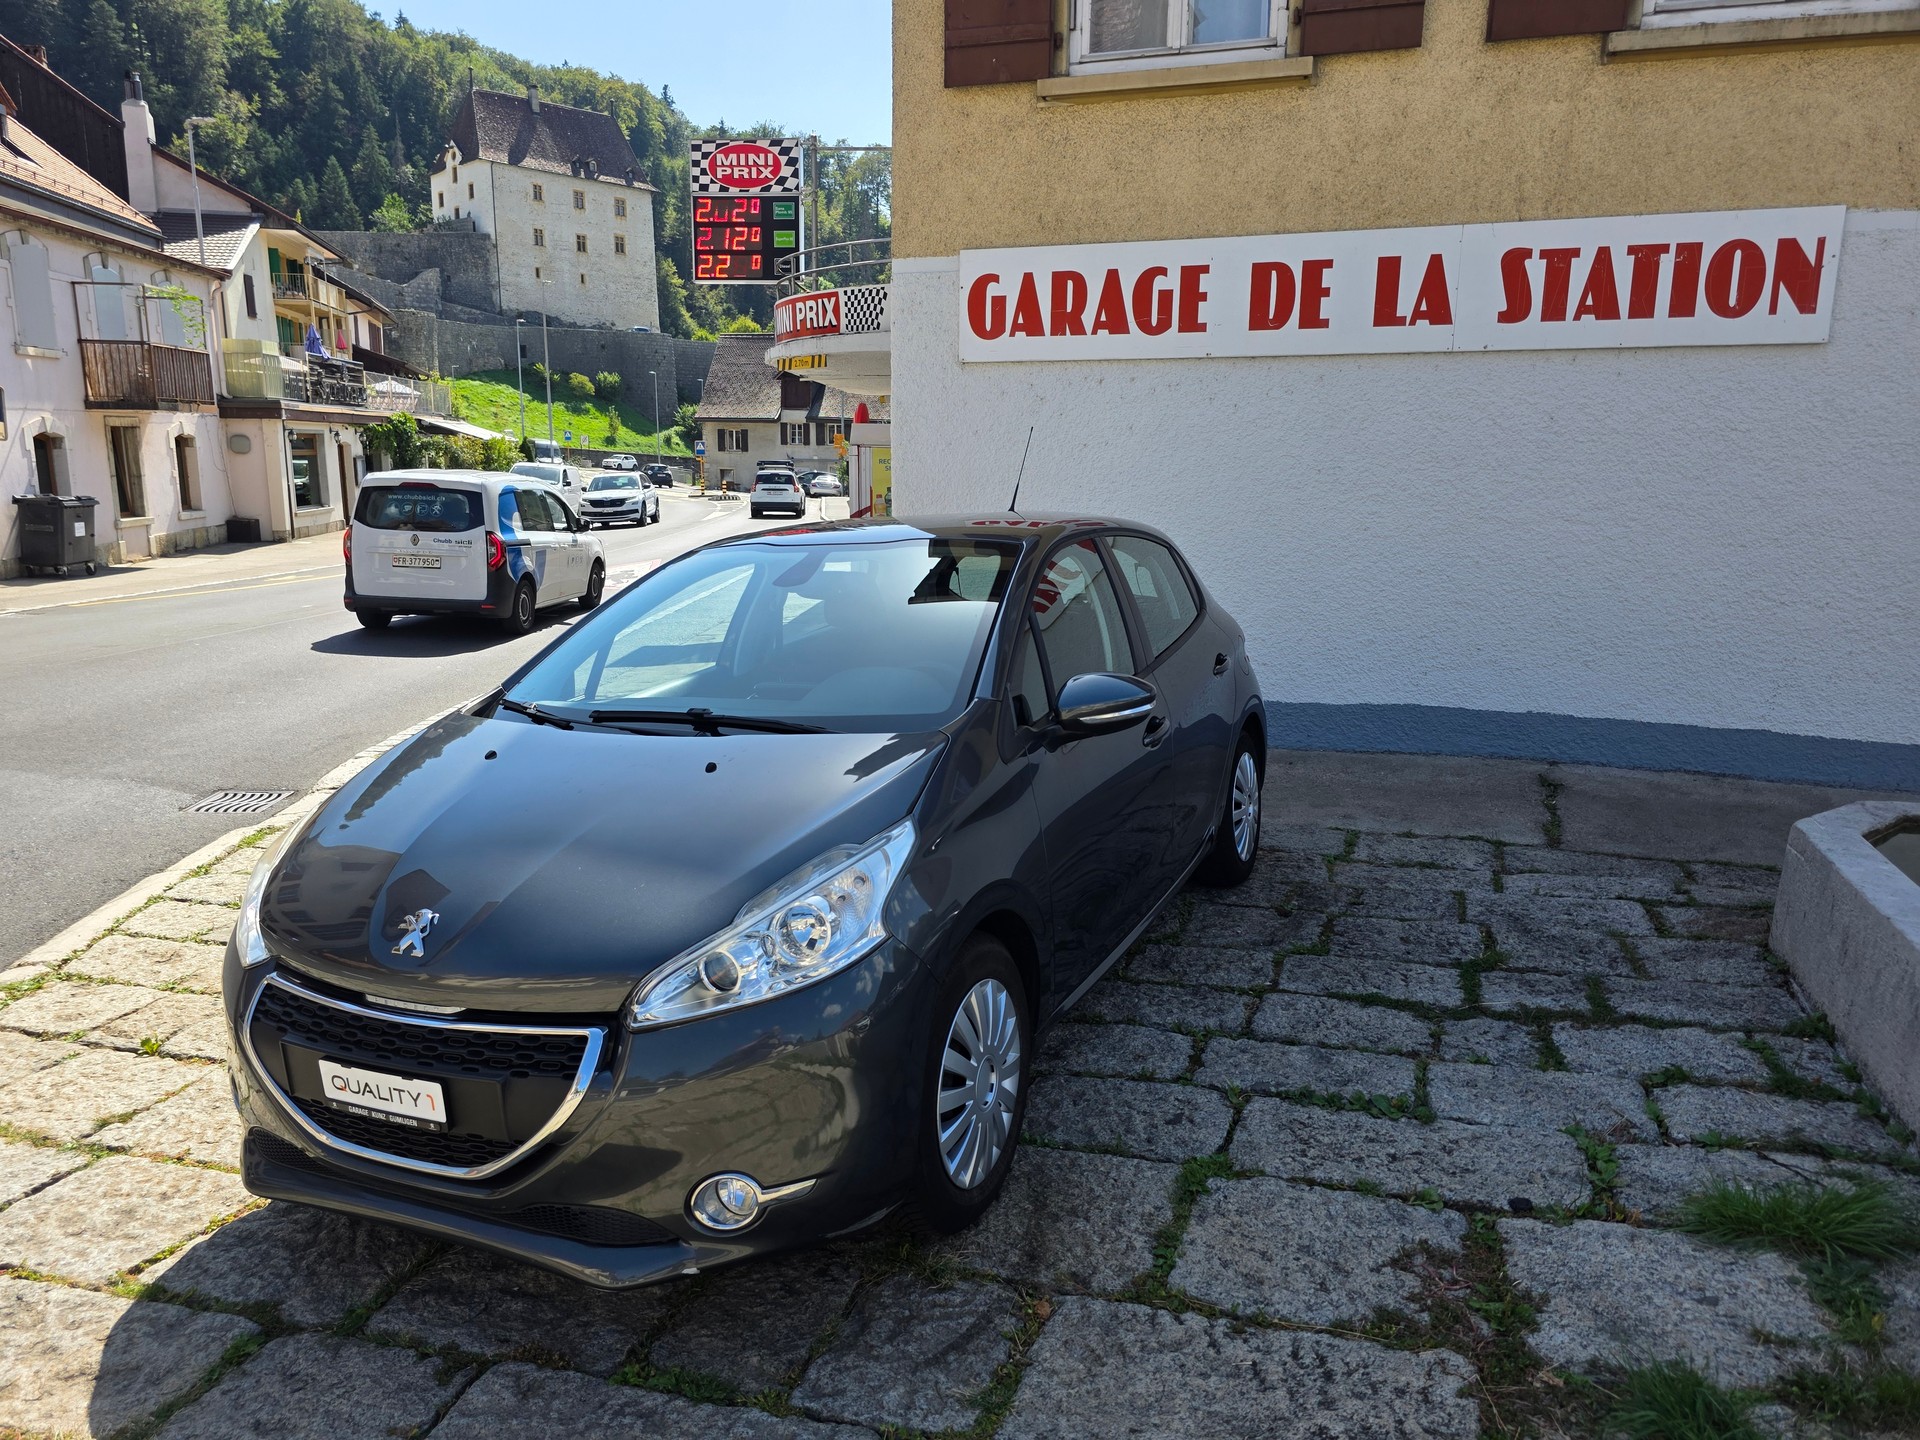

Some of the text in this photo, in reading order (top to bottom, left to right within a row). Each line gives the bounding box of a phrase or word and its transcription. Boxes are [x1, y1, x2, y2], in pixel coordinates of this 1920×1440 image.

[715, 152, 774, 166] MINI
[716, 166, 775, 179] PRIX
[968, 236, 1827, 340] GARAGE DE LA STATION
[776, 297, 838, 335] MINI PRIX
[348, 1105, 369, 1117] GARAGE
[371, 1110, 387, 1120] KUNZ
